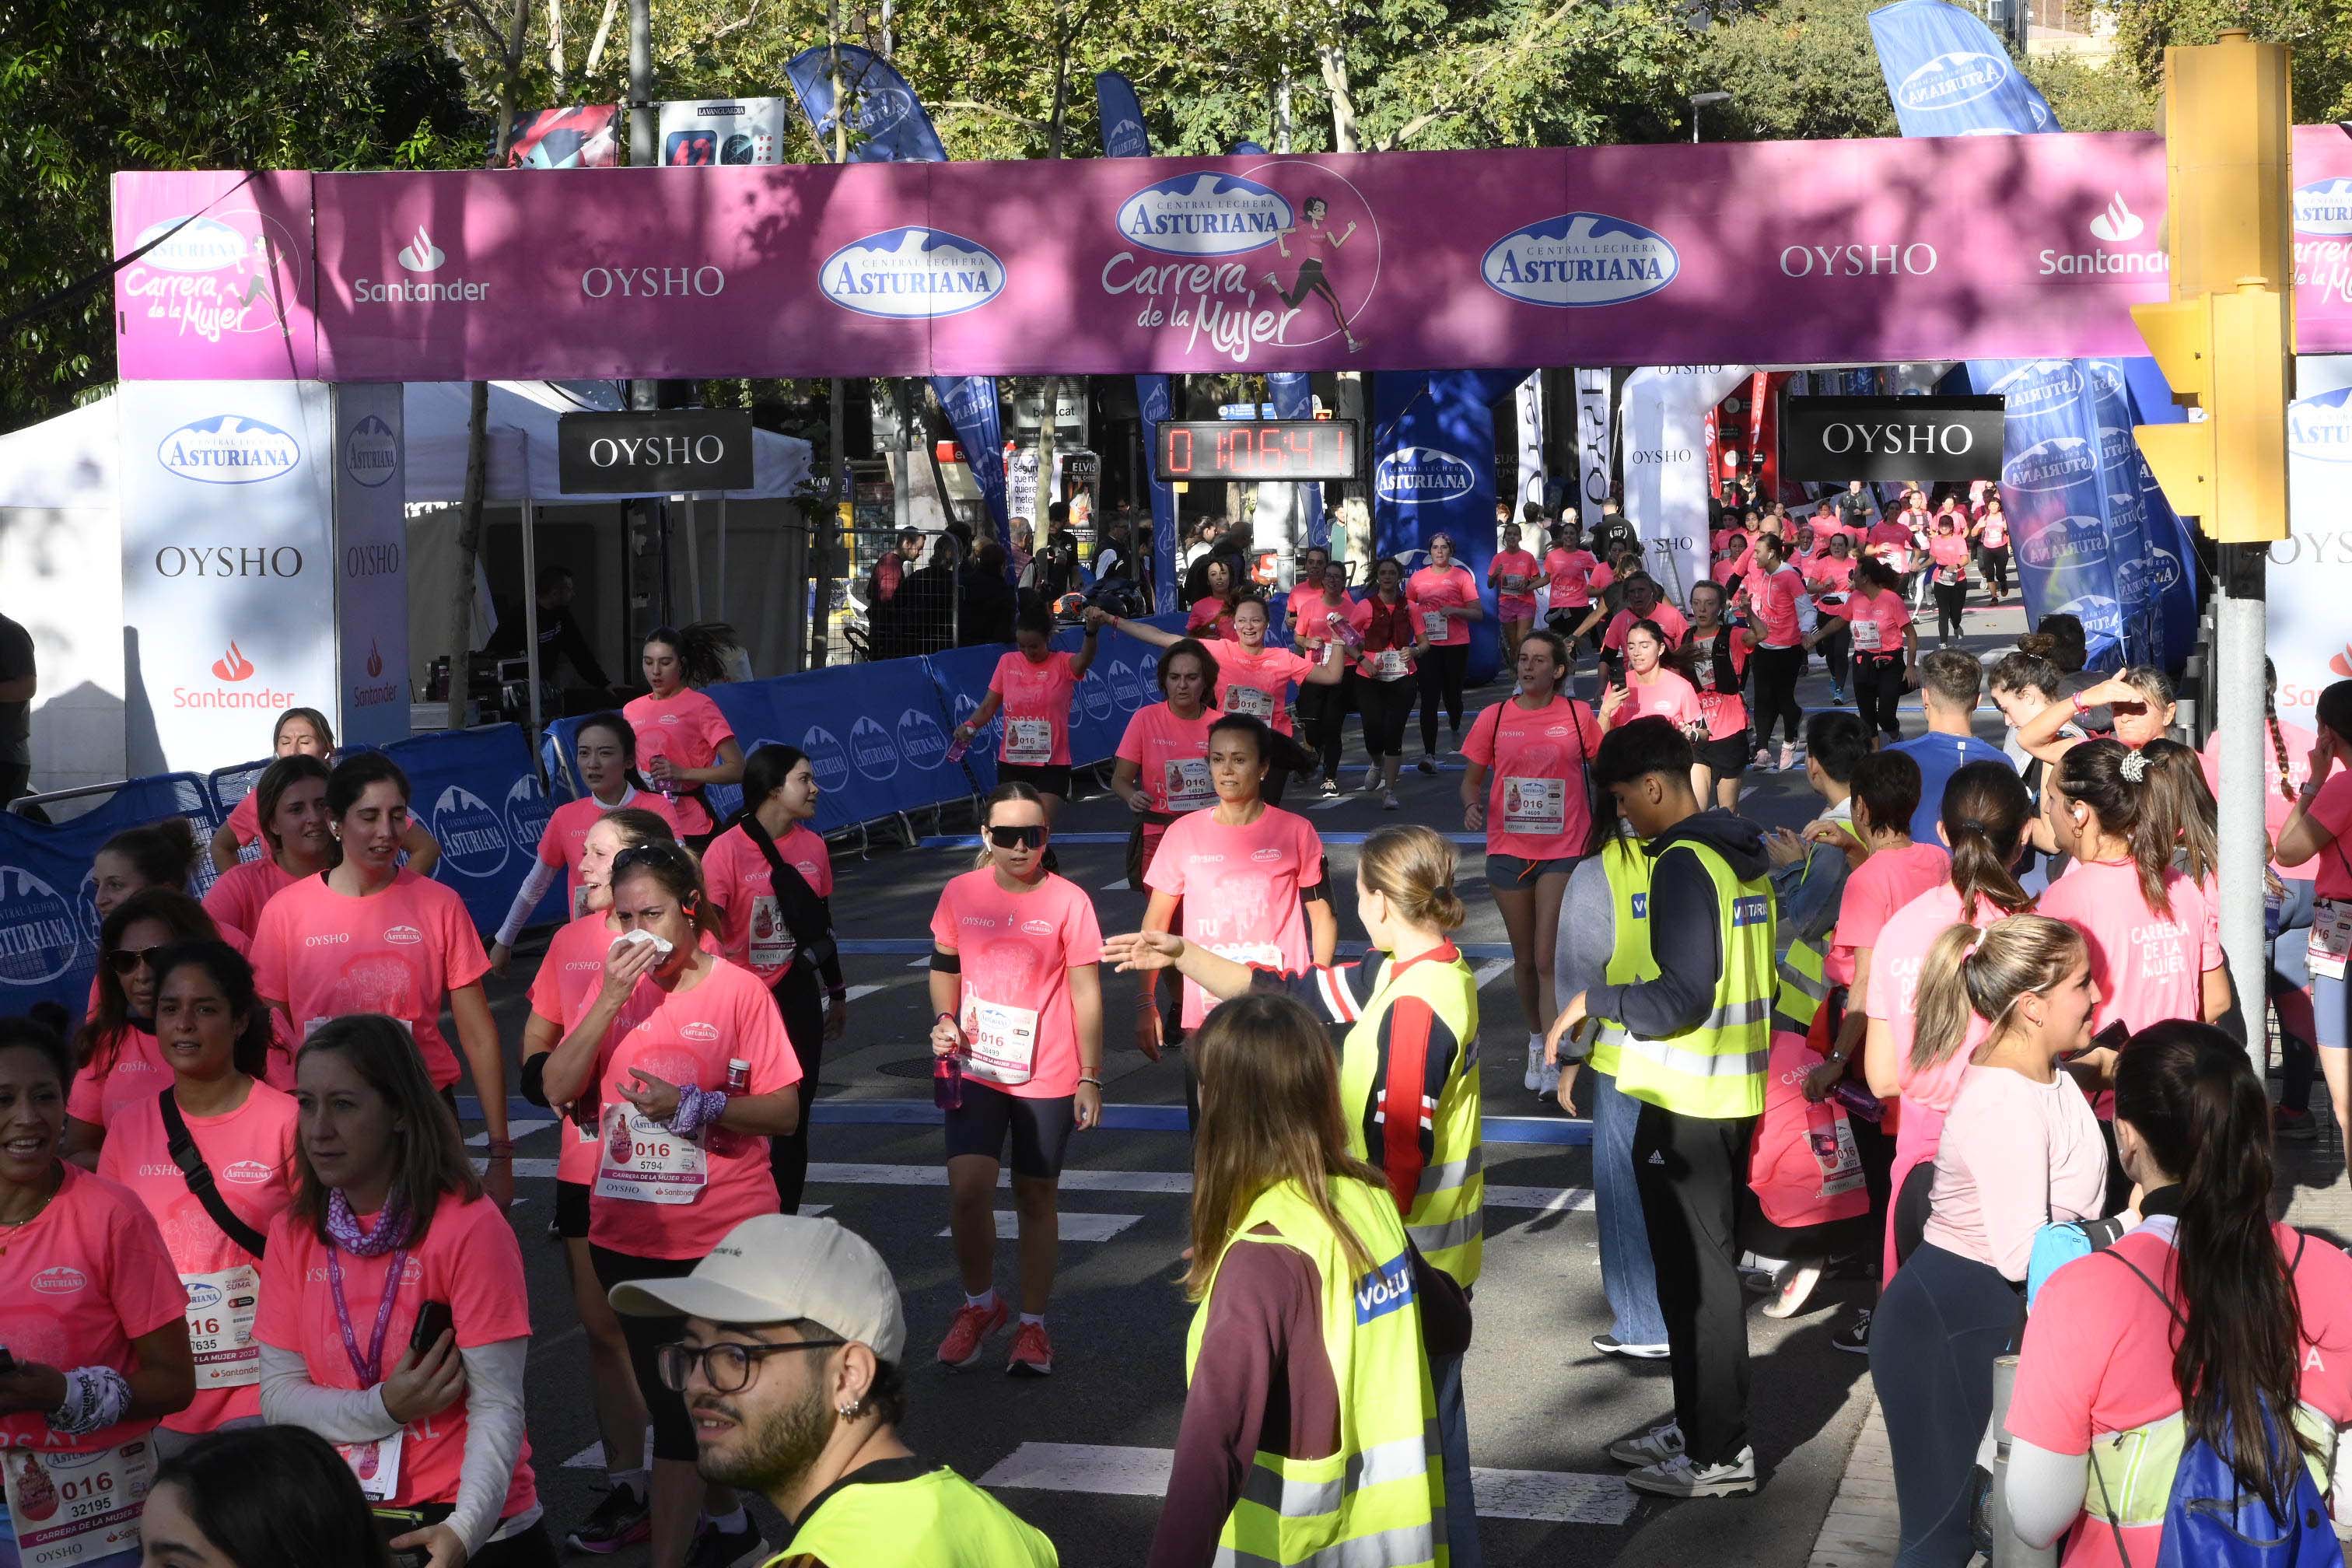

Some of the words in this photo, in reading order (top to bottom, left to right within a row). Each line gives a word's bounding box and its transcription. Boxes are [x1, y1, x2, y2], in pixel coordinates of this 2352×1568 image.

[1157, 201, 1213, 209] CENTRAL
[1219, 199, 1275, 208] LECHERA
[1130, 204, 1282, 235] ASTURIANA
[1527, 246, 1587, 256] CENTRAL
[1594, 243, 1657, 255] LECHERA
[1780, 243, 1937, 277] OYSHO
[862, 257, 921, 268] CENTRAL
[926, 255, 985, 268] LECHERA
[1497, 249, 1664, 283] ASTURIANA
[2039, 249, 2168, 275] Santand
[125, 268, 217, 297] Carrera
[582, 266, 725, 299] OYSHO
[833, 261, 992, 295] ASTURIANA
[1101, 252, 1247, 296] Carrera
[355, 278, 490, 303] Santander
[148, 299, 165, 310] de
[169, 298, 181, 310] la
[1137, 297, 1164, 327] de
[1170, 297, 1189, 327] la
[179, 292, 250, 342] Mujer
[1185, 290, 1301, 362] Mujer
[1822, 422, 1973, 455] OYSHO
[169, 441, 290, 467] ASTURIANA
[349, 445, 395, 470] ASTURIANA
[590, 434, 724, 467] OYSHO
[1633, 449, 1691, 464] OYSHO
[1073, 463, 1096, 472] ELVIS
[1379, 470, 1468, 491] ASTURIANA
[1656, 537, 1692, 551] SHO
[156, 545, 303, 578] OYSHO
[347, 542, 399, 579] OYSHO
[173, 688, 295, 709] Santander
[354, 683, 398, 709] Santander
[1185, 778, 1206, 787] 016
[1523, 800, 1543, 808] 016
[440, 822, 506, 858] ASTURIANA
[387, 933, 421, 942] ASTURIANA
[1197, 918, 1218, 936] TU
[306, 933, 349, 948] OYSHO
[2144, 942, 2161, 961] DE
[2165, 940, 2182, 955] LA
[565, 961, 600, 971] OYSHO
[2141, 955, 2186, 978] MUJER
[681, 1027, 717, 1039] ASTURIANA
[981, 1031, 1004, 1047] 016
[635, 1142, 670, 1157] 016
[1838, 1146, 1856, 1159] 016
[226, 1167, 268, 1179] ASTURIANA
[640, 1161, 663, 1171] 5794
[607, 1182, 639, 1195] OYSHO
[36, 1276, 84, 1289] ASTURIANA
[226, 1282, 251, 1291] SUMA
[191, 1318, 220, 1335] 16
[211, 1353, 236, 1361] MUJER
[239, 1349, 256, 1358] 2023
[61, 1471, 114, 1501] 016
[71, 1497, 111, 1517] 32195
[36, 1526, 77, 1542] CARRERA
[79, 1521, 92, 1531] DE
[93, 1517, 103, 1526] LA
[105, 1509, 132, 1524] MUJER
[36, 1542, 82, 1563] OYSHO
